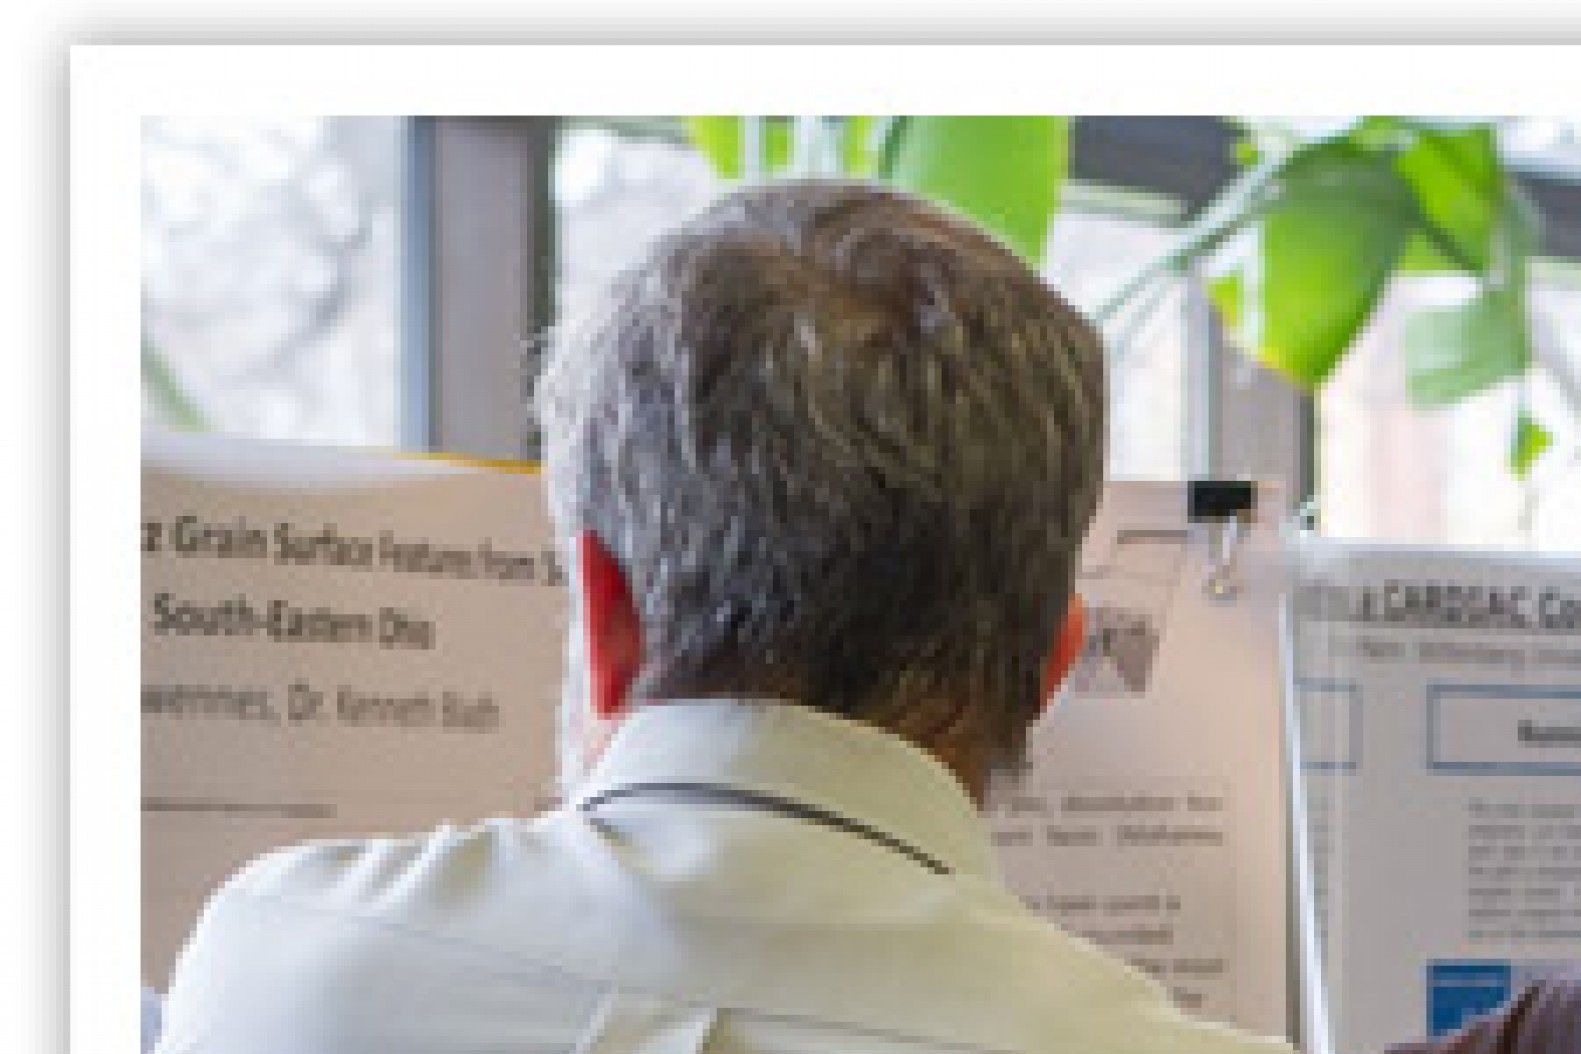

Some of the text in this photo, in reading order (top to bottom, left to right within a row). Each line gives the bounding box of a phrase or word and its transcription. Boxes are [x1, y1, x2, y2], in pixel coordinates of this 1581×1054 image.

[174, 515, 268, 559] Grain
[273, 521, 374, 567] Surface
[153, 592, 373, 643] South-Eastern
